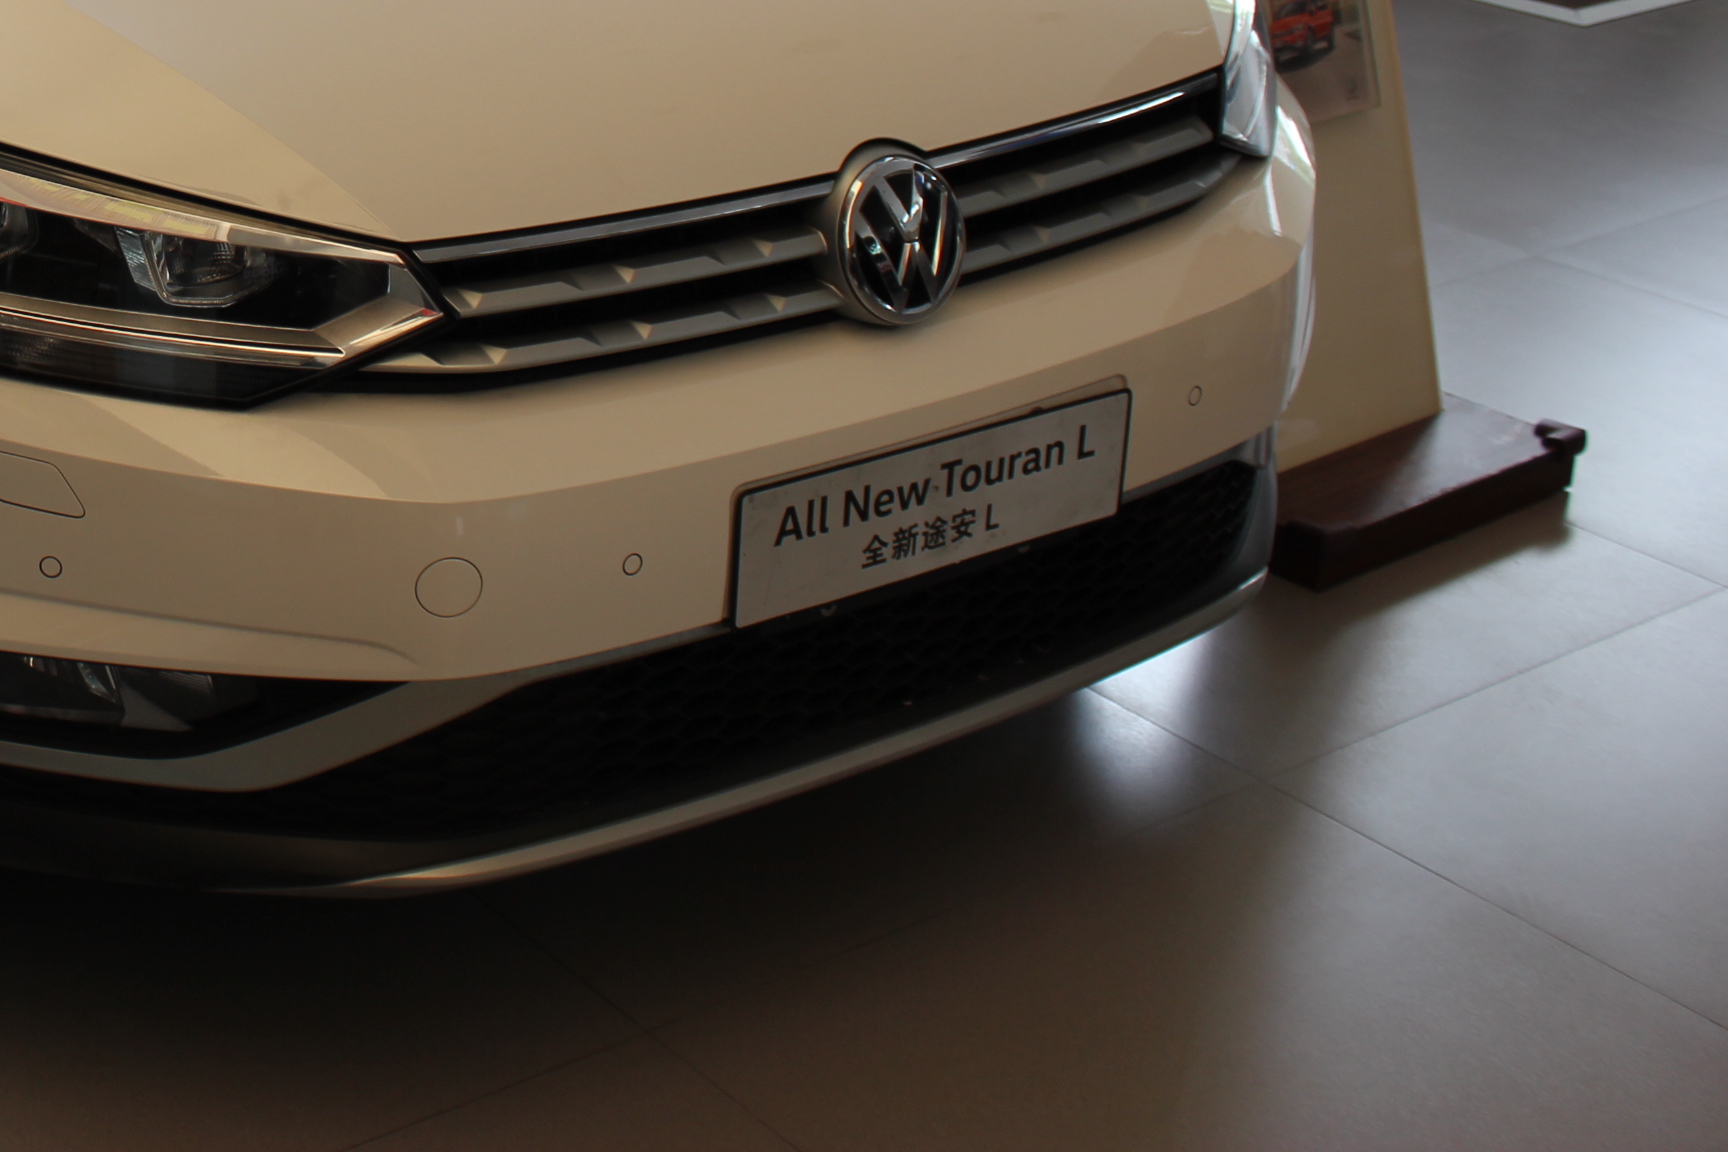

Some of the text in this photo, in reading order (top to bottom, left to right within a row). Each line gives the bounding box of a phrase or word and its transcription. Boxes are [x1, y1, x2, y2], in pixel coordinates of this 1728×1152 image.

[773, 424, 1096, 548] All New Touran L
[860, 503, 1000, 570] 全新途安 L
